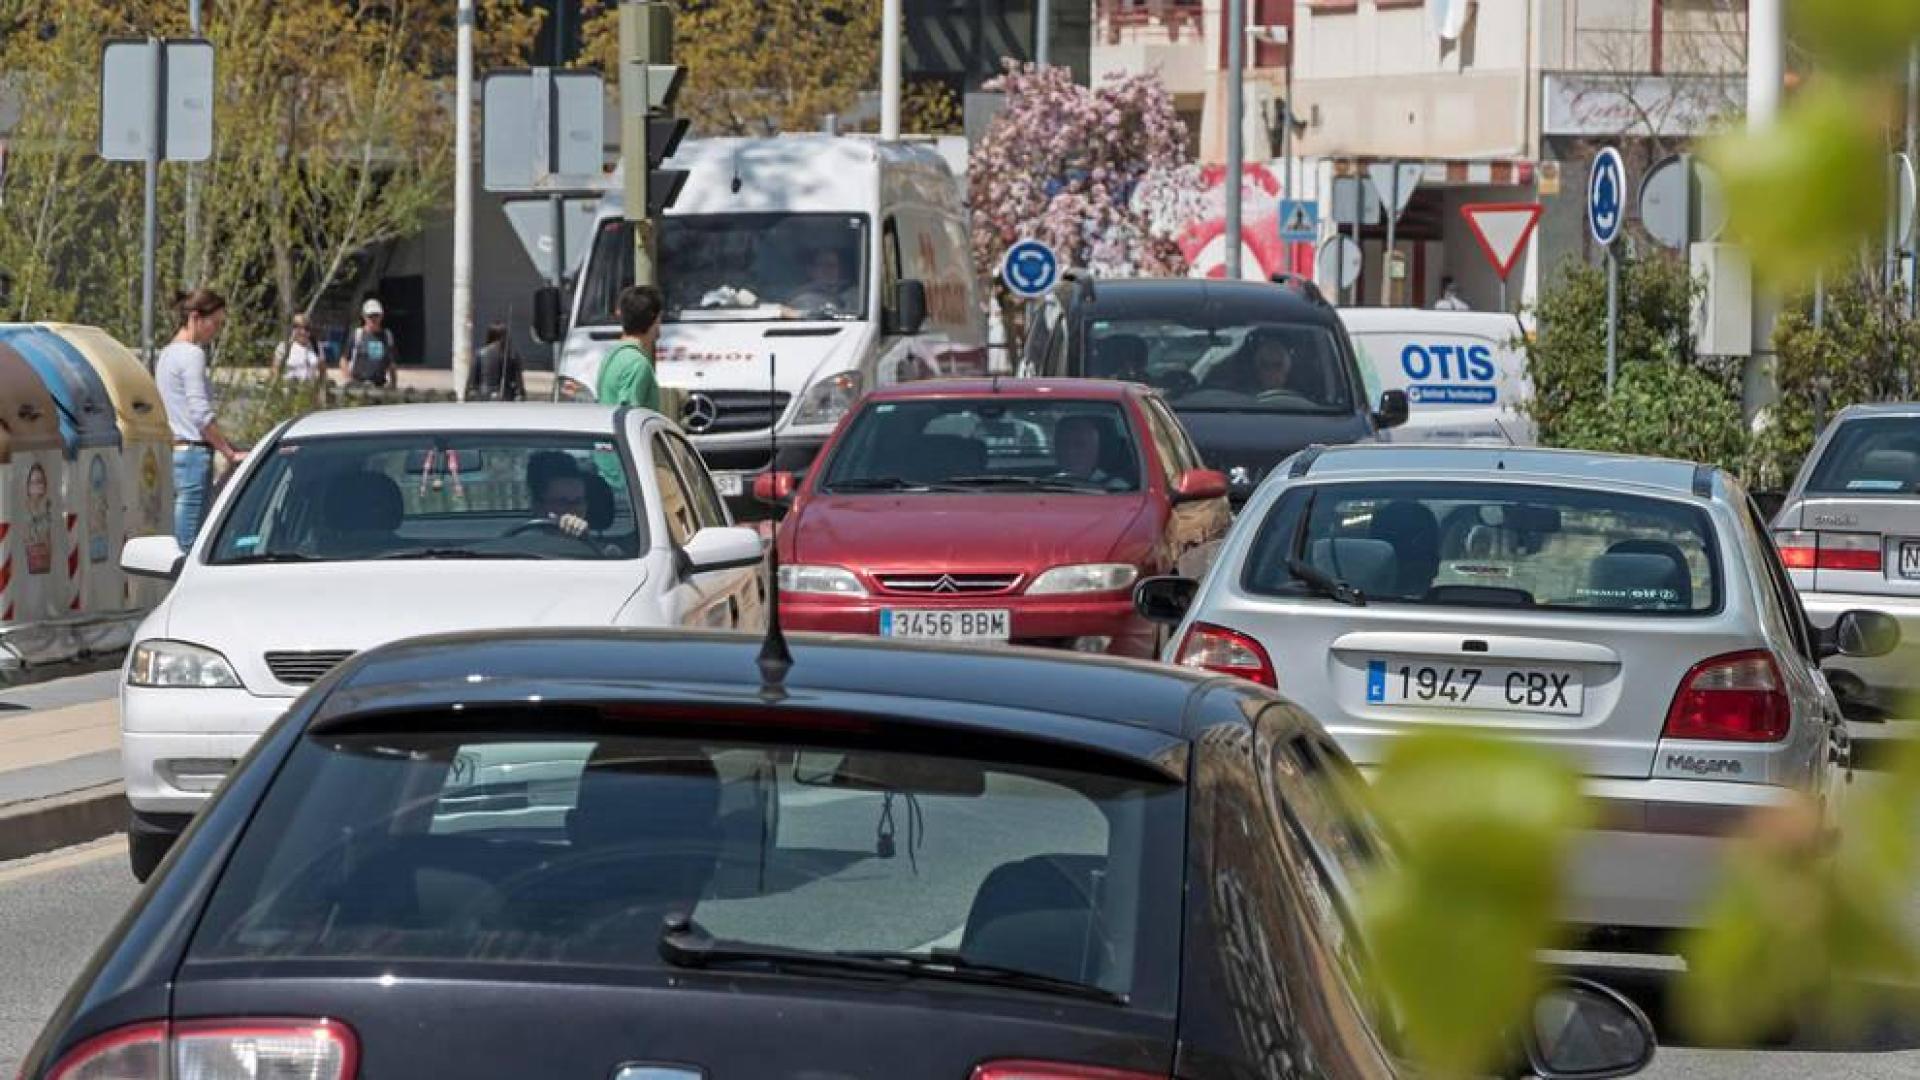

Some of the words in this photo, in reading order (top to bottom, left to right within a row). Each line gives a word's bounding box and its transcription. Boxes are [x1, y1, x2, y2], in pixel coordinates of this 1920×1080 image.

[1402, 344, 1495, 381] OTIS
[897, 613, 953, 636] 3456
[961, 612, 1004, 635] BBM
[1400, 666, 1482, 703] 1947
[1505, 671, 1570, 708] CBX
